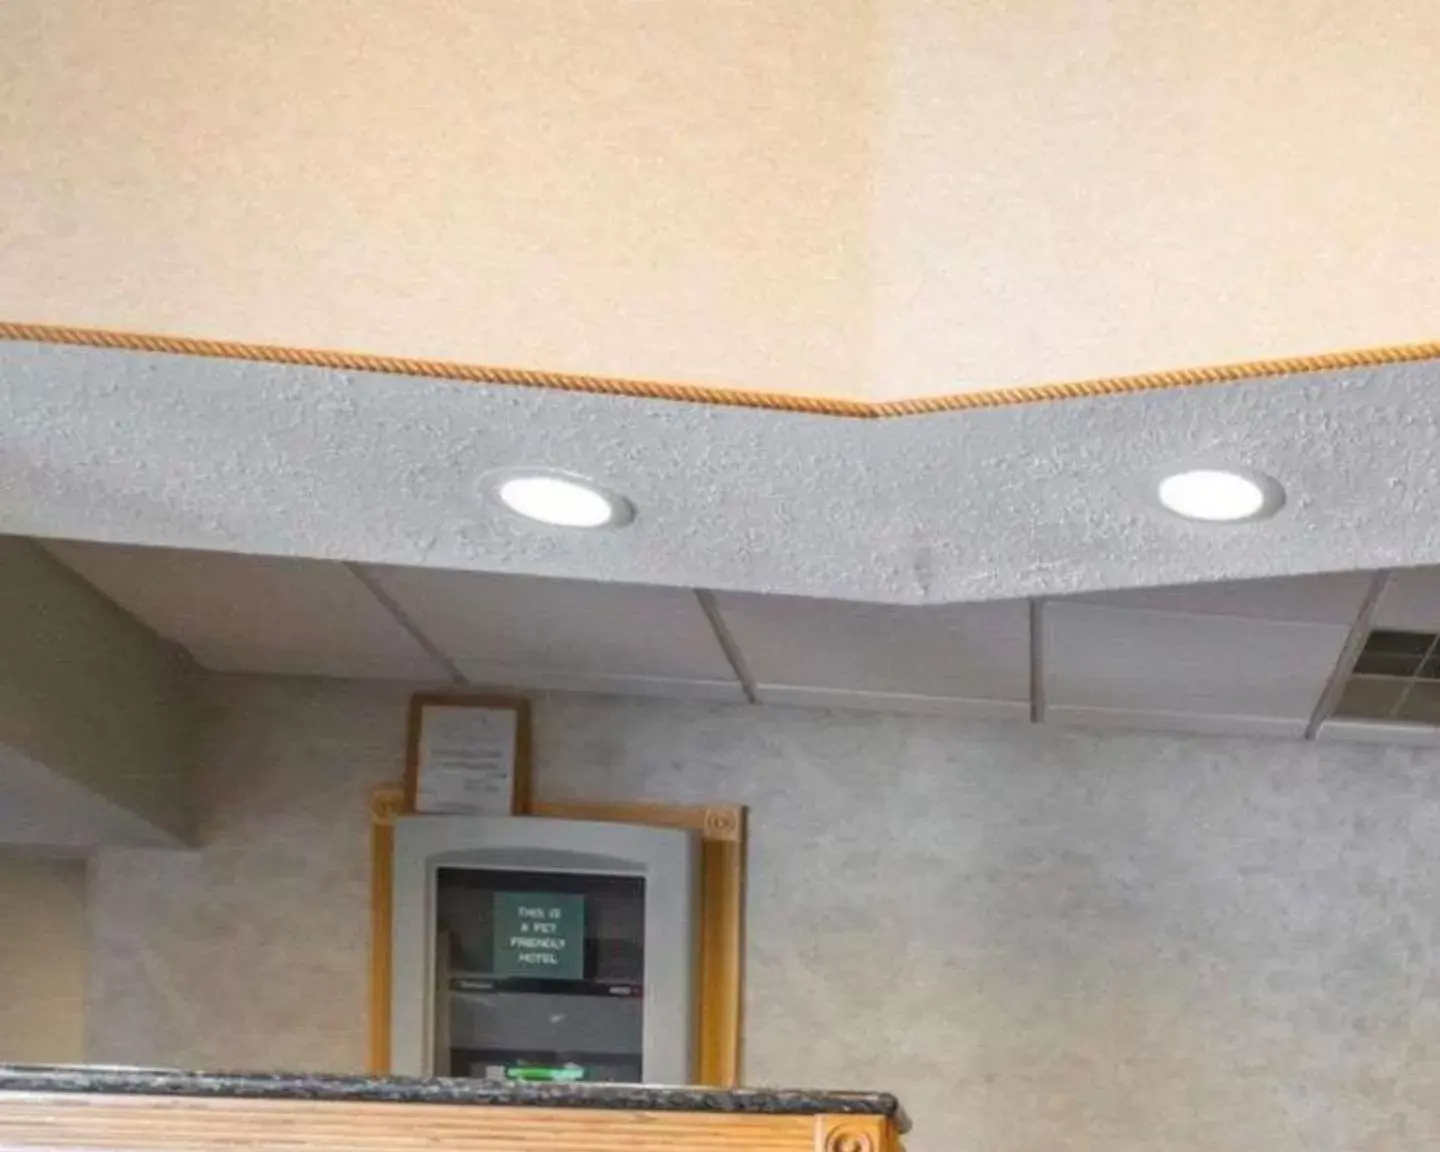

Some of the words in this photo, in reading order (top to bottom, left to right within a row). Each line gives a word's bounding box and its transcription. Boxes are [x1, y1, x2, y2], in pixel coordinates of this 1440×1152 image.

[518, 906, 545, 919] THIS
[533, 922, 557, 934] PET
[509, 936, 567, 951] FRIENDLY
[518, 952, 559, 966] HOTEL
